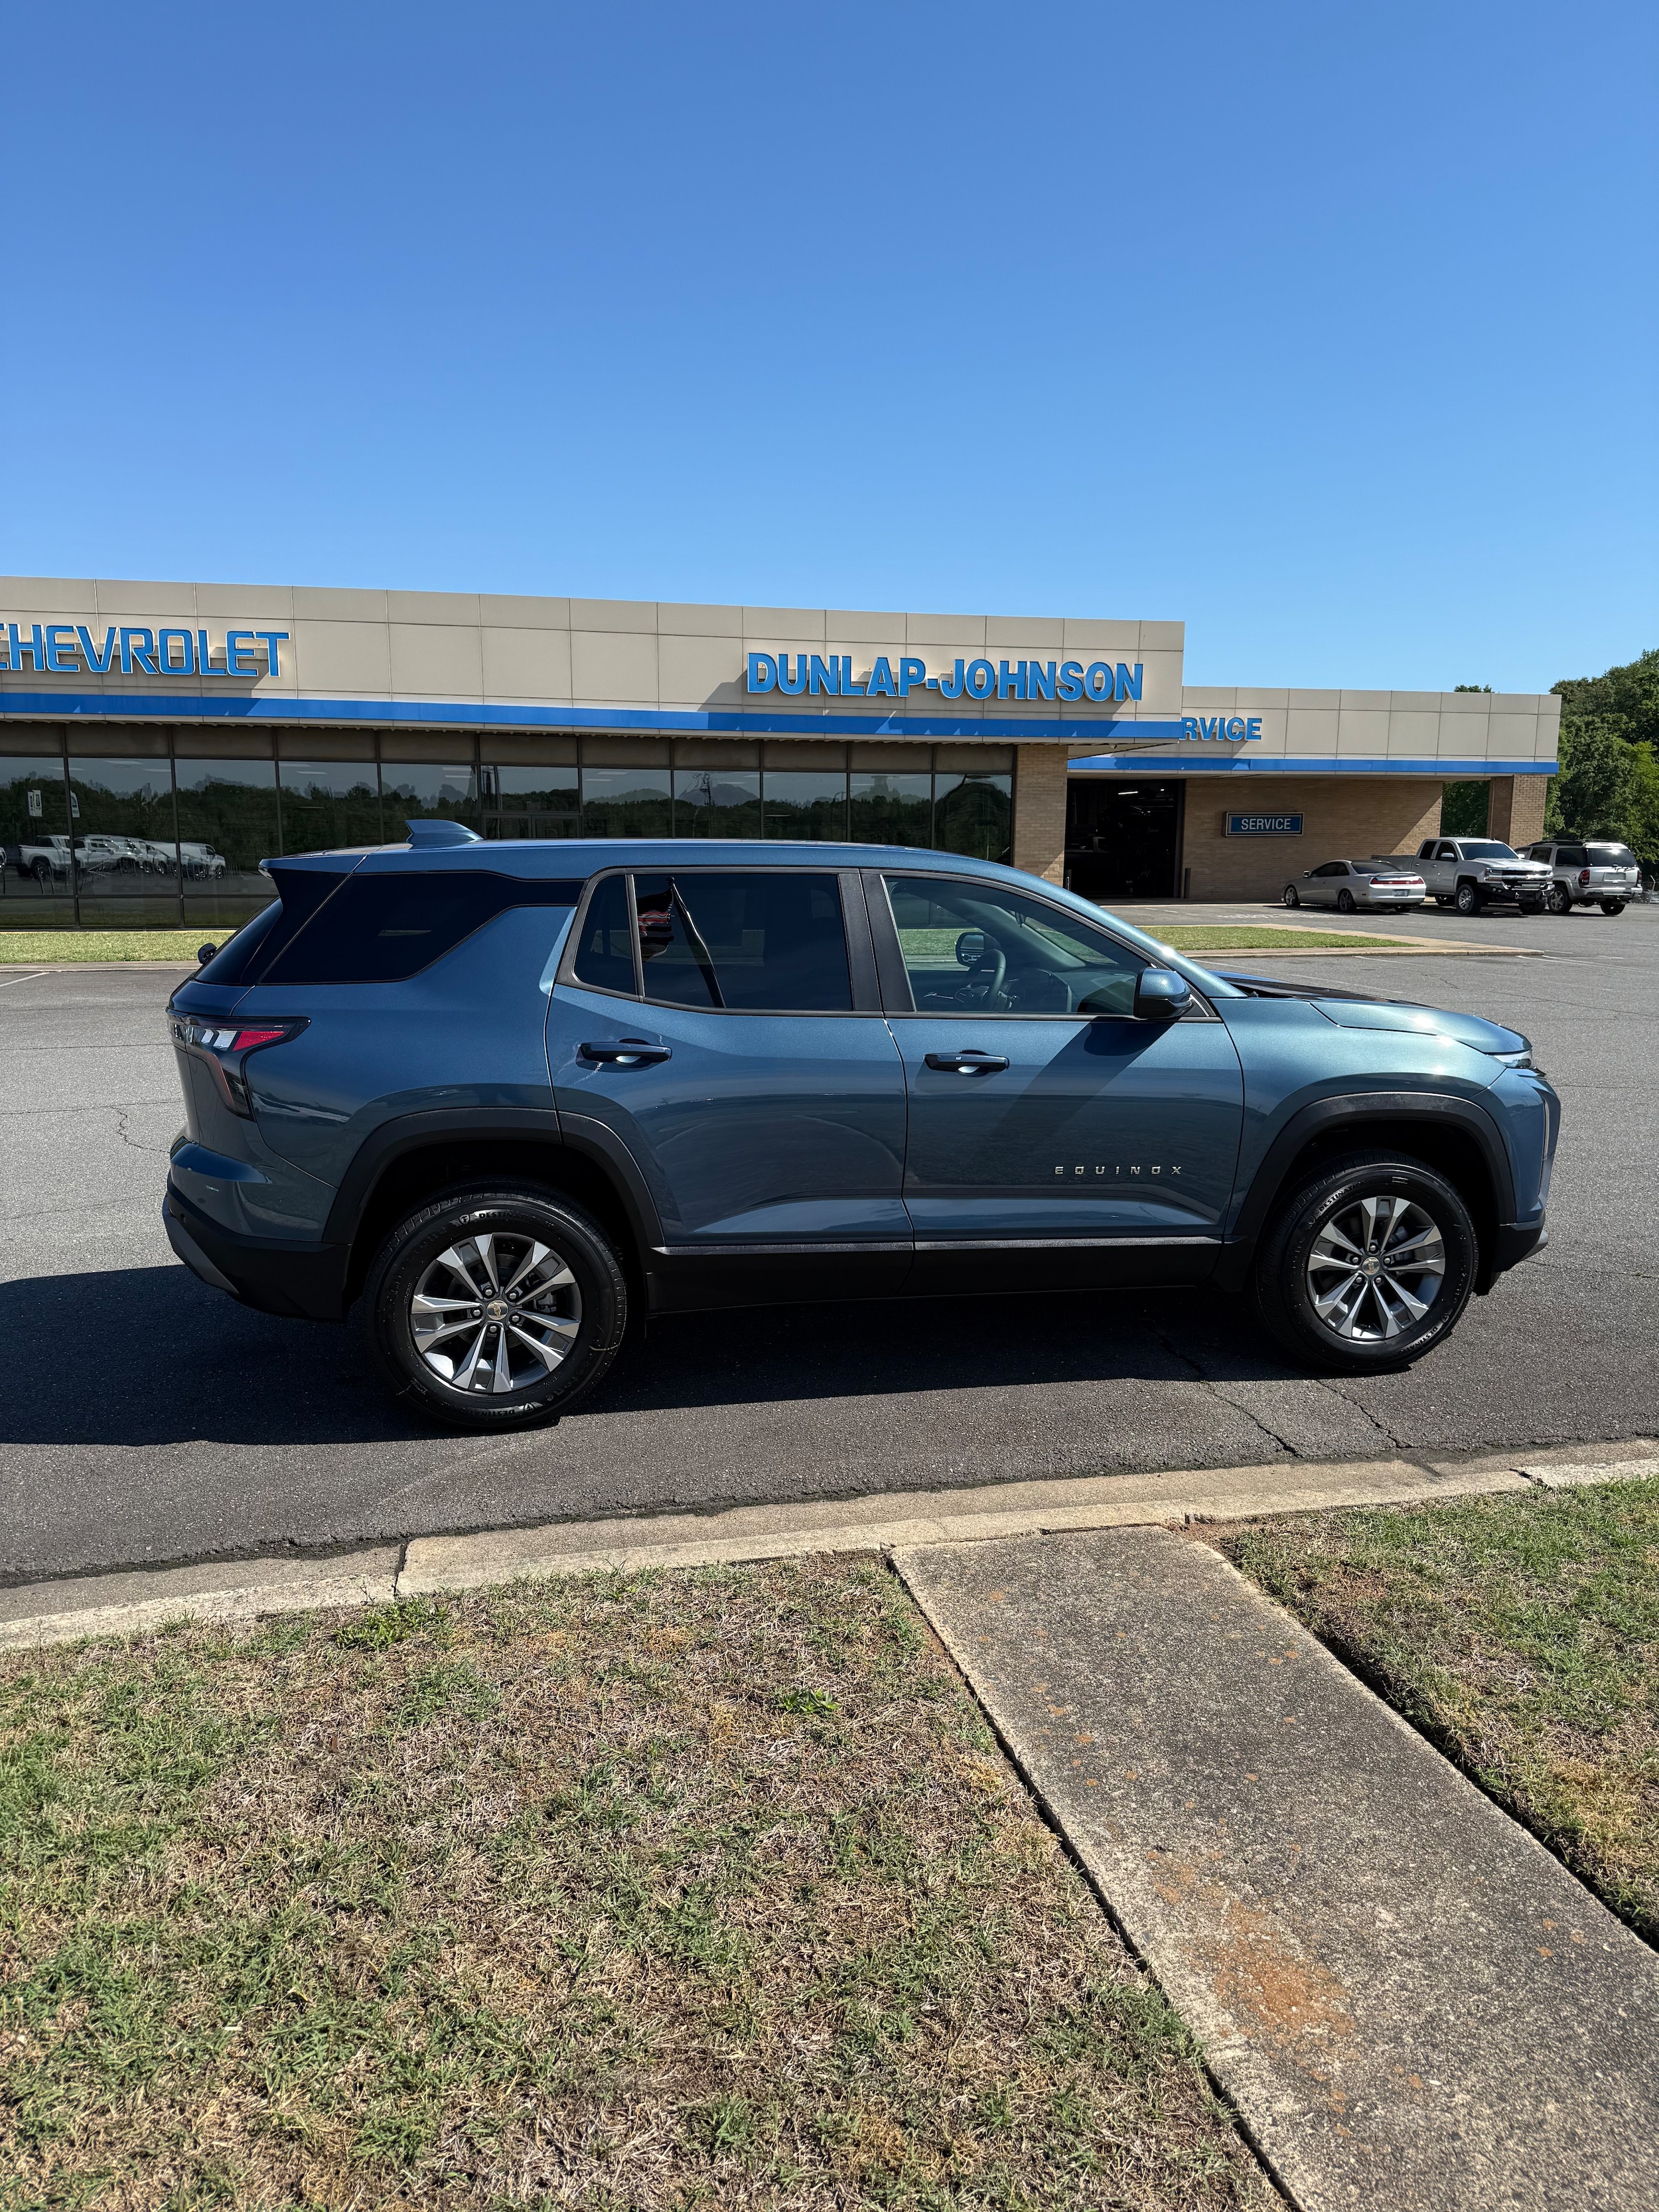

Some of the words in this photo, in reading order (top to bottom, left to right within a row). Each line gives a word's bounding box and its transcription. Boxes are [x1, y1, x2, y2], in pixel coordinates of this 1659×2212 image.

[0, 623, 289, 677] HEVROLET
[747, 652, 1143, 702] DUNLAP-JOHNSON
[1240, 818, 1291, 830] SERVICE
[1054, 1165, 1182, 1175] EQUINOX
